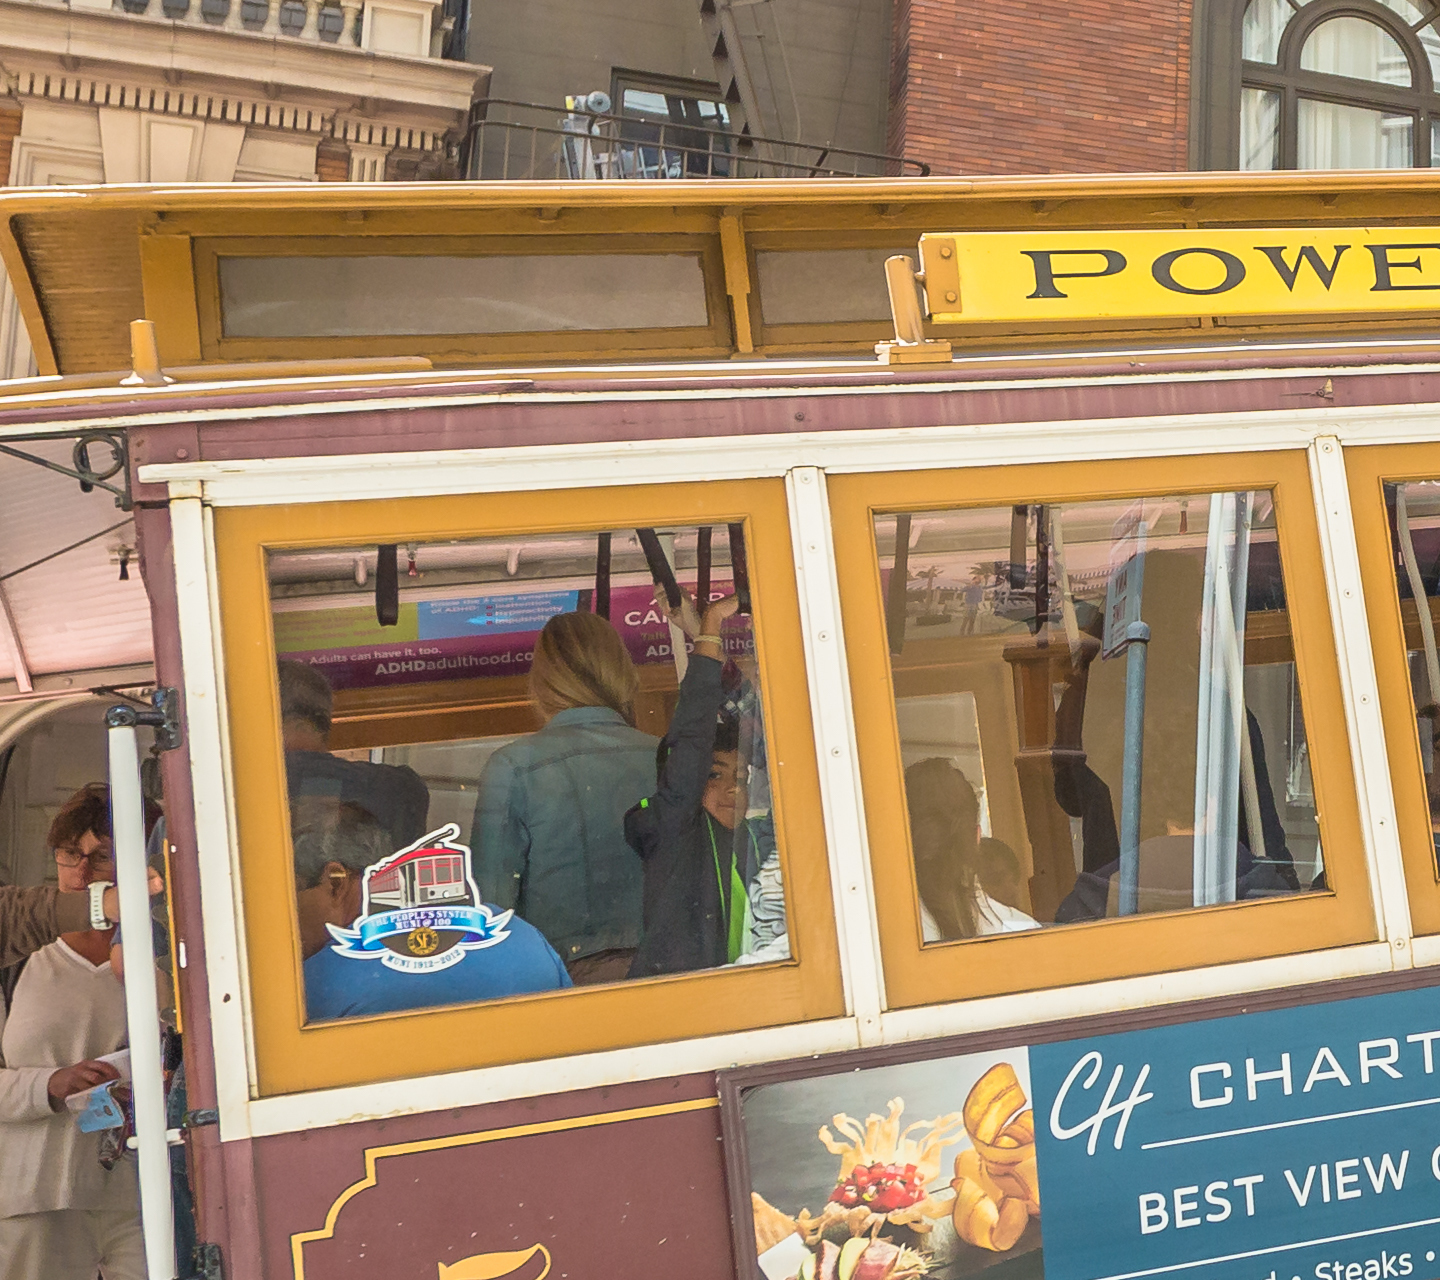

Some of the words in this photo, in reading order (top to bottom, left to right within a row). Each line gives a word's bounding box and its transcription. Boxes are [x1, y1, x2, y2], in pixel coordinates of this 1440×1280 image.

[309, 653, 348, 666] Adults
[350, 651, 371, 662] can
[373, 647, 402, 660] have
[418, 645, 443, 656] too.
[374, 650, 535, 677] ADHDadulthood.co
[1049, 1050, 1154, 1156] CH
[1138, 1173, 1266, 1236] BEST
[1283, 1149, 1411, 1208] VIEW
